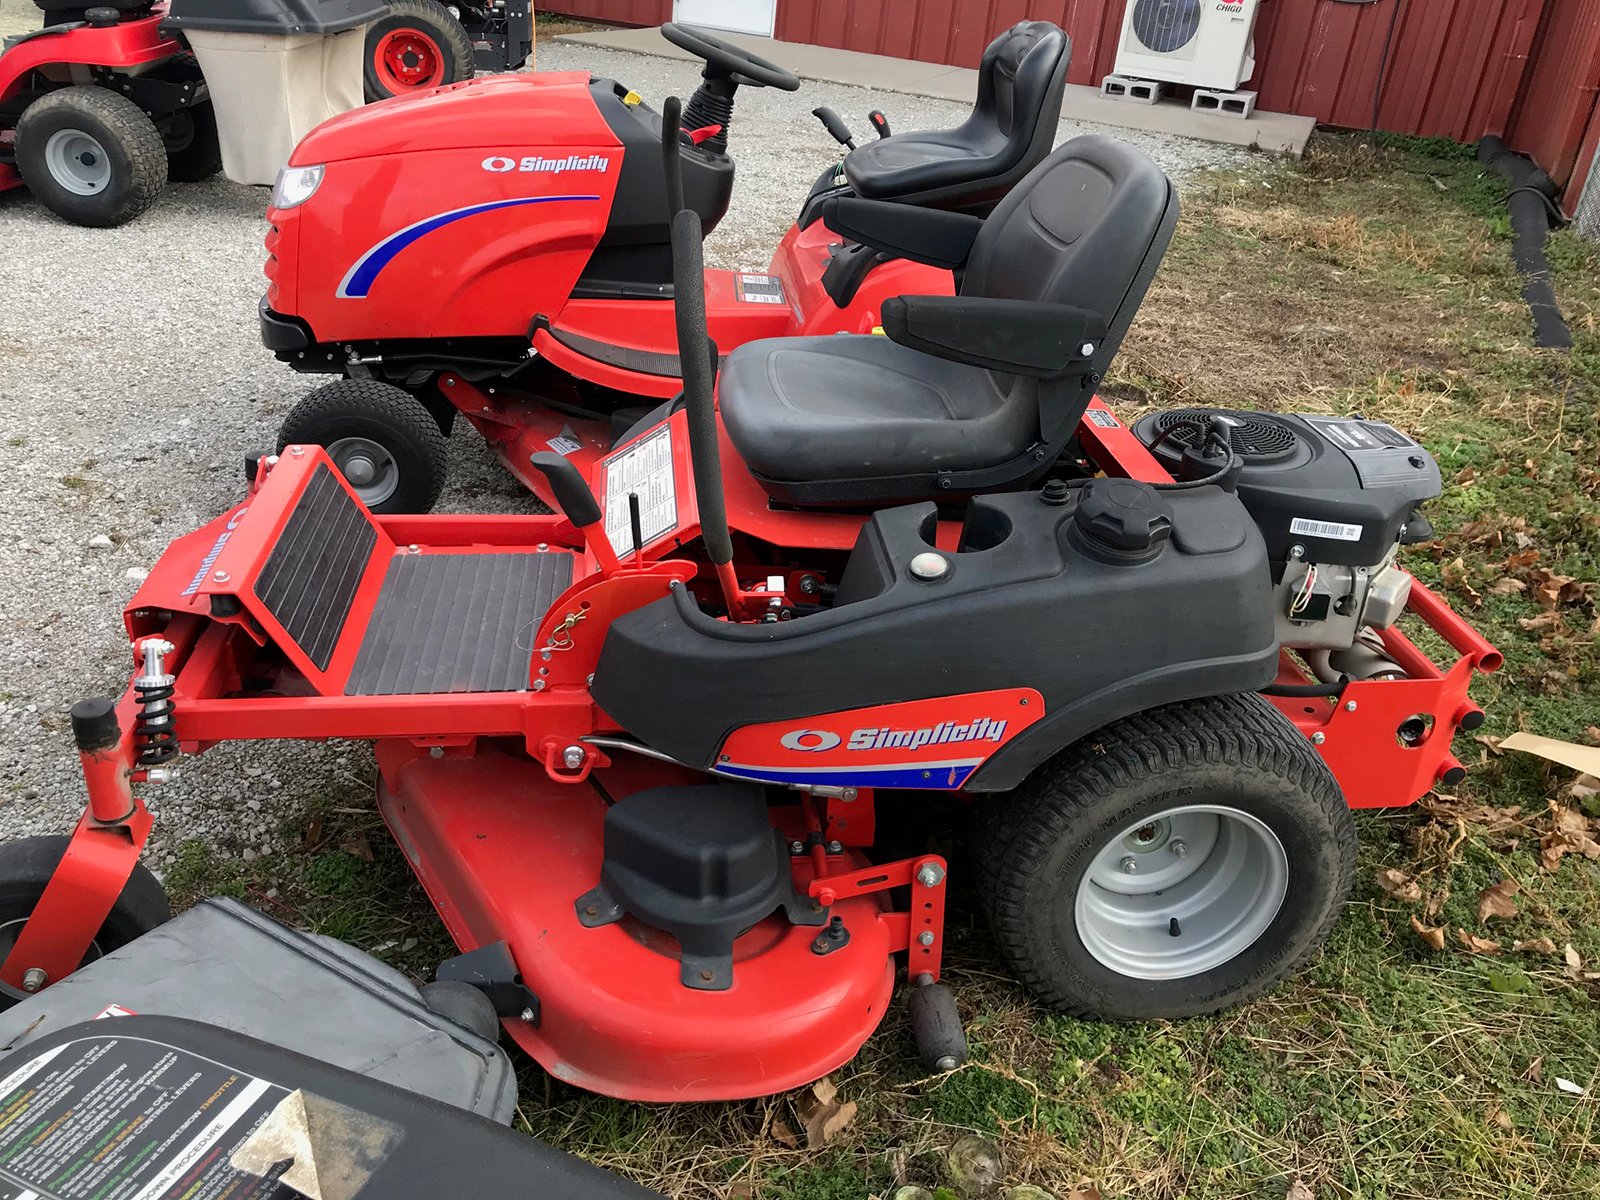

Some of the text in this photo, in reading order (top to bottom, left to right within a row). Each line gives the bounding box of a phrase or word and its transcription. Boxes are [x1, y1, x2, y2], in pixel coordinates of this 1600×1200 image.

[1216, 4, 1242, 13] CHIGO
[518, 155, 609, 173] Simplicity
[847, 717, 1008, 751] Simplicity
[84, 1045, 99, 1059] OFF
[16, 1096, 48, 1123] MOTION
[49, 1063, 87, 1096] CONTROL
[86, 1038, 117, 1066] LEVERS
[54, 1130, 84, 1158] CHOKE
[83, 1107, 109, 1132] DOWN
[109, 1091, 128, 1109] once
[128, 1070, 153, 1092] engine
[152, 1051, 173, 1069] starts
[69, 1118, 108, 1155] SECONDS
[108, 1108, 120, 1119] for
[120, 1085, 146, 1109] engine
[144, 1056, 178, 1086] WARMUP
[31, 1109, 74, 1146] THROTTLE
[33, 1128, 63, 1156] CHOKE
[62, 1118, 74, 1130] UP
[74, 1108, 86, 1119] for
[86, 1093, 103, 1109] cold
[43, 1123, 80, 1157] IGNITION
[79, 1109, 97, 1125] KEY
[105, 1078, 130, 1102] START
[83, 1164, 103, 1181] both
[101, 1134, 136, 1164] MOTION
[133, 1099, 174, 1134] CONTROL
[170, 1071, 202, 1099] LEVERS
[92, 1140, 117, 1162] PARK
[114, 1114, 145, 1142] BRAKE
[152, 1091, 169, 1106] OFF
[94, 1118, 129, 1149] operate
[132, 1160, 151, 1177] mow
[199, 1073, 237, 1111] THROTTLE
[85, 1153, 128, 1190] NEUTRAL
[119, 1139, 159, 1174] machine
[170, 1121, 224, 1175] PROCEDURE
[203, 1155, 227, 1180] switch
[226, 1134, 247, 1156] down
[246, 1126, 255, 1136] to
[254, 1110, 270, 1127] OFF
[259, 1179, 269, 1190] to
